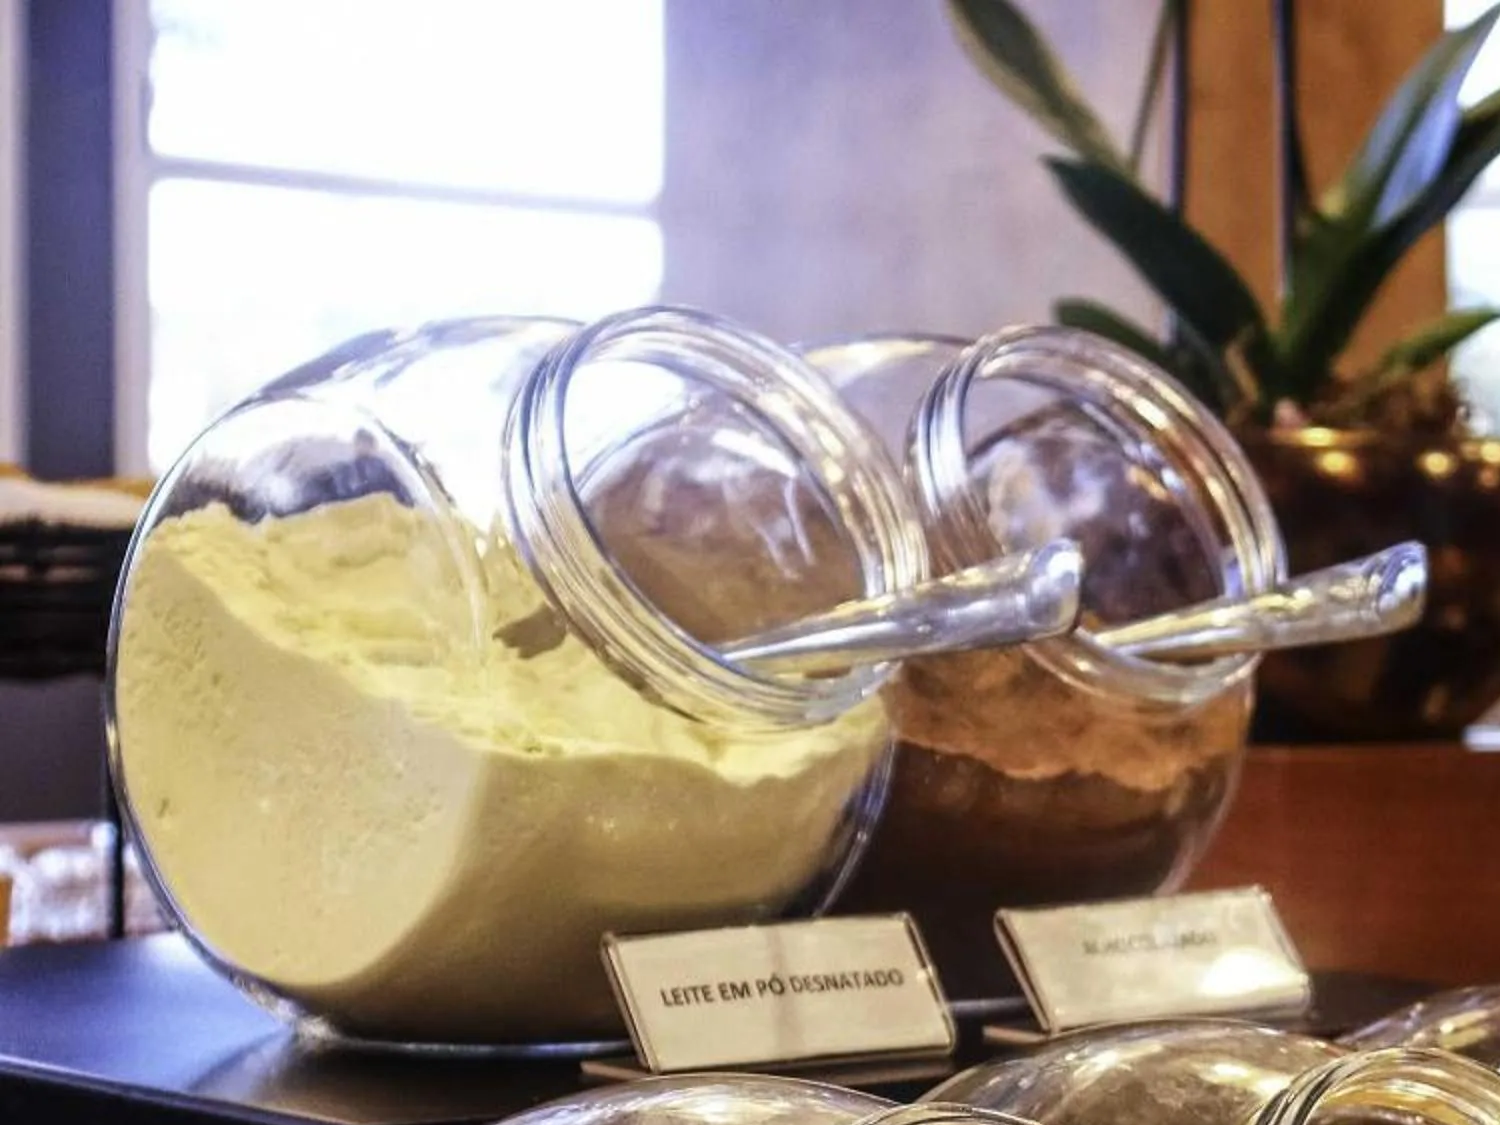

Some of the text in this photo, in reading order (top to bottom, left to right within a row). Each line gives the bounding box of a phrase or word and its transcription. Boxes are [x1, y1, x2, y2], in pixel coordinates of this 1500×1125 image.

[660, 968, 905, 1006] LEITE EM PÓ DESNATADO
